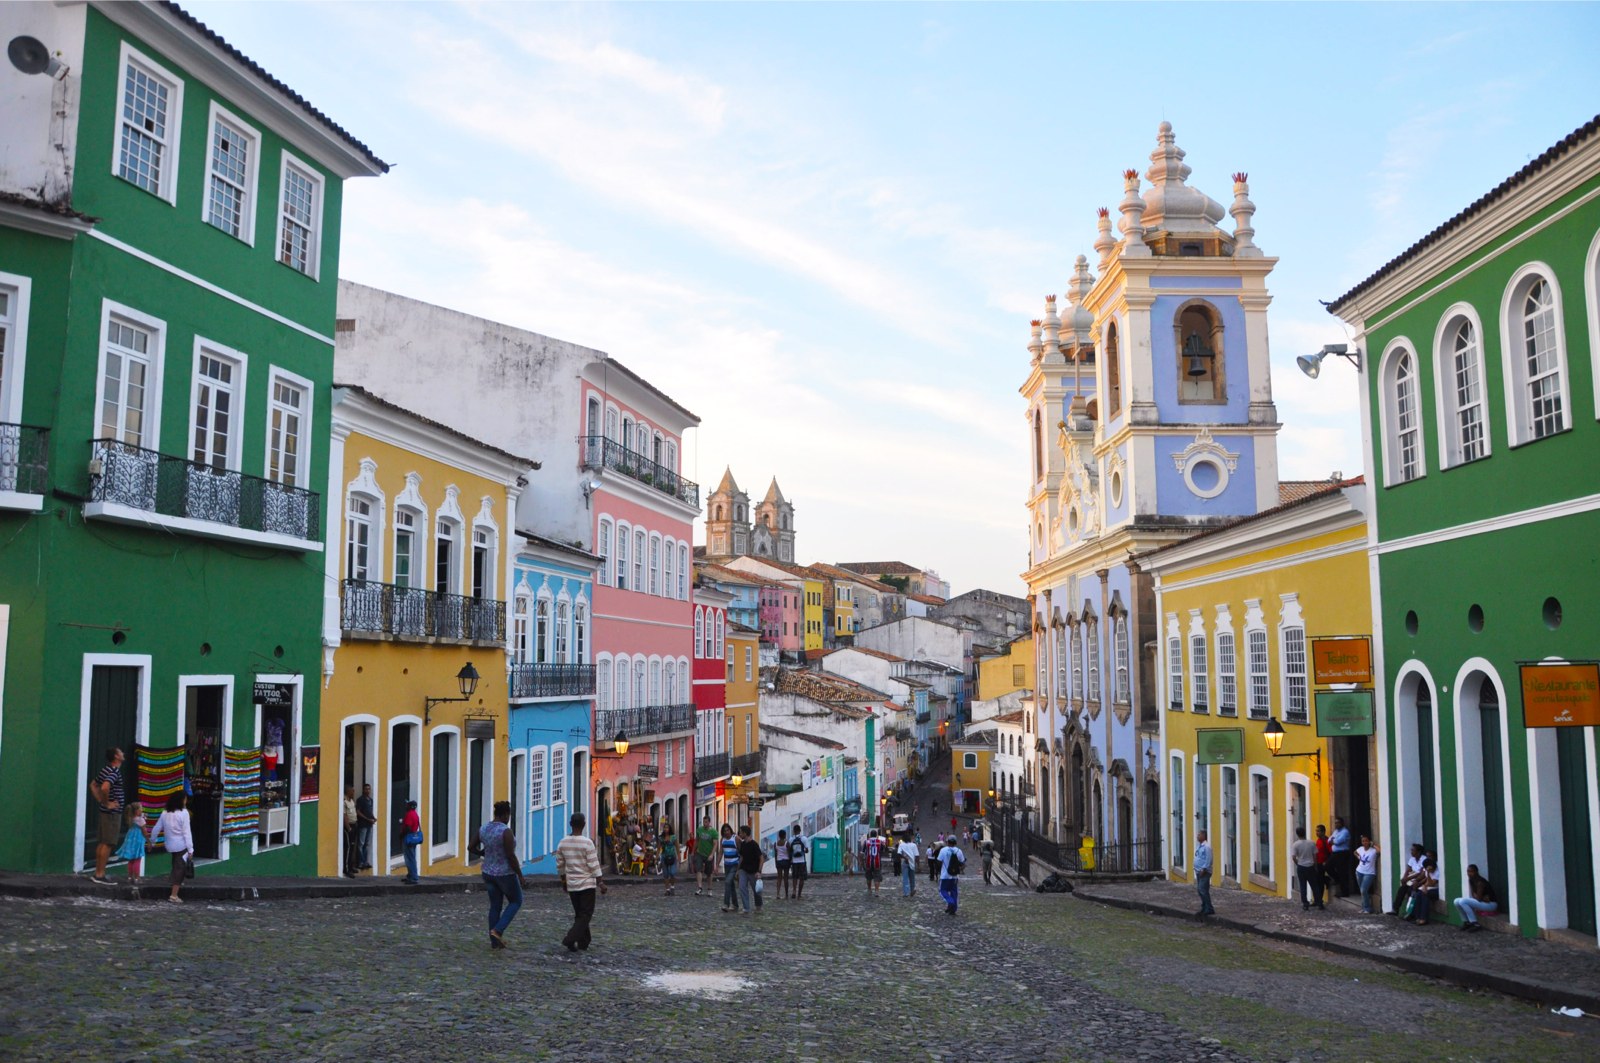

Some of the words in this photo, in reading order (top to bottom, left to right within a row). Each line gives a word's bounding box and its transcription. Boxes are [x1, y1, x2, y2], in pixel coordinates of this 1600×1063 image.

[1323, 651, 1359, 664] Teatro
[1528, 678, 1596, 691] Restaurante
[254, 690, 281, 698] TATTOO
